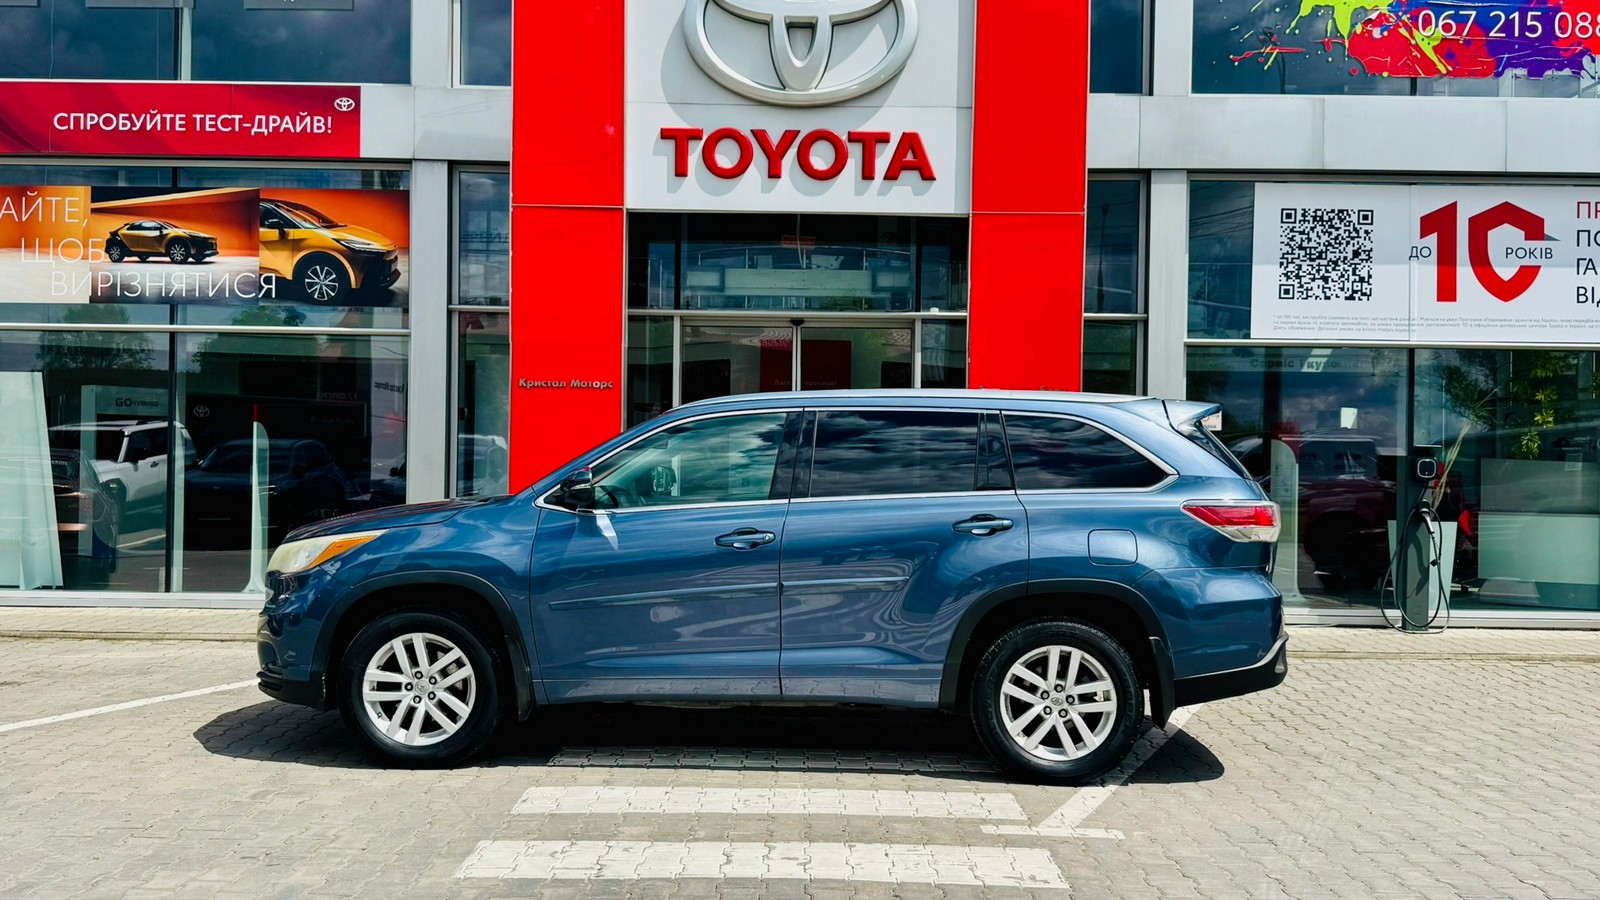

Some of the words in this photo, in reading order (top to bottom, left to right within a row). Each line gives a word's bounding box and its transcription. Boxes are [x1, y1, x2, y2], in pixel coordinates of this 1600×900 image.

[1418, 10, 1477, 37] 067
[1488, 11, 1542, 38] 215
[1554, 11, 1600, 39] 08
[53, 110, 186, 132] СПРОБУЙТЕ
[193, 111, 332, 136] ТЕСТ-ДРАЙВ!
[660, 127, 936, 181] TOYOTA
[0, 190, 88, 227] АЙТЕ,
[20, 237, 106, 268] ЩОБ
[1408, 246, 1432, 261] ДО
[1505, 247, 1554, 260] РОКІВ
[51, 271, 276, 299] ВИРІЗНЯТИСЯ
[1577, 286, 1600, 307] ВІ
[519, 378, 566, 388] Кристал
[570, 379, 613, 389] Моторс
